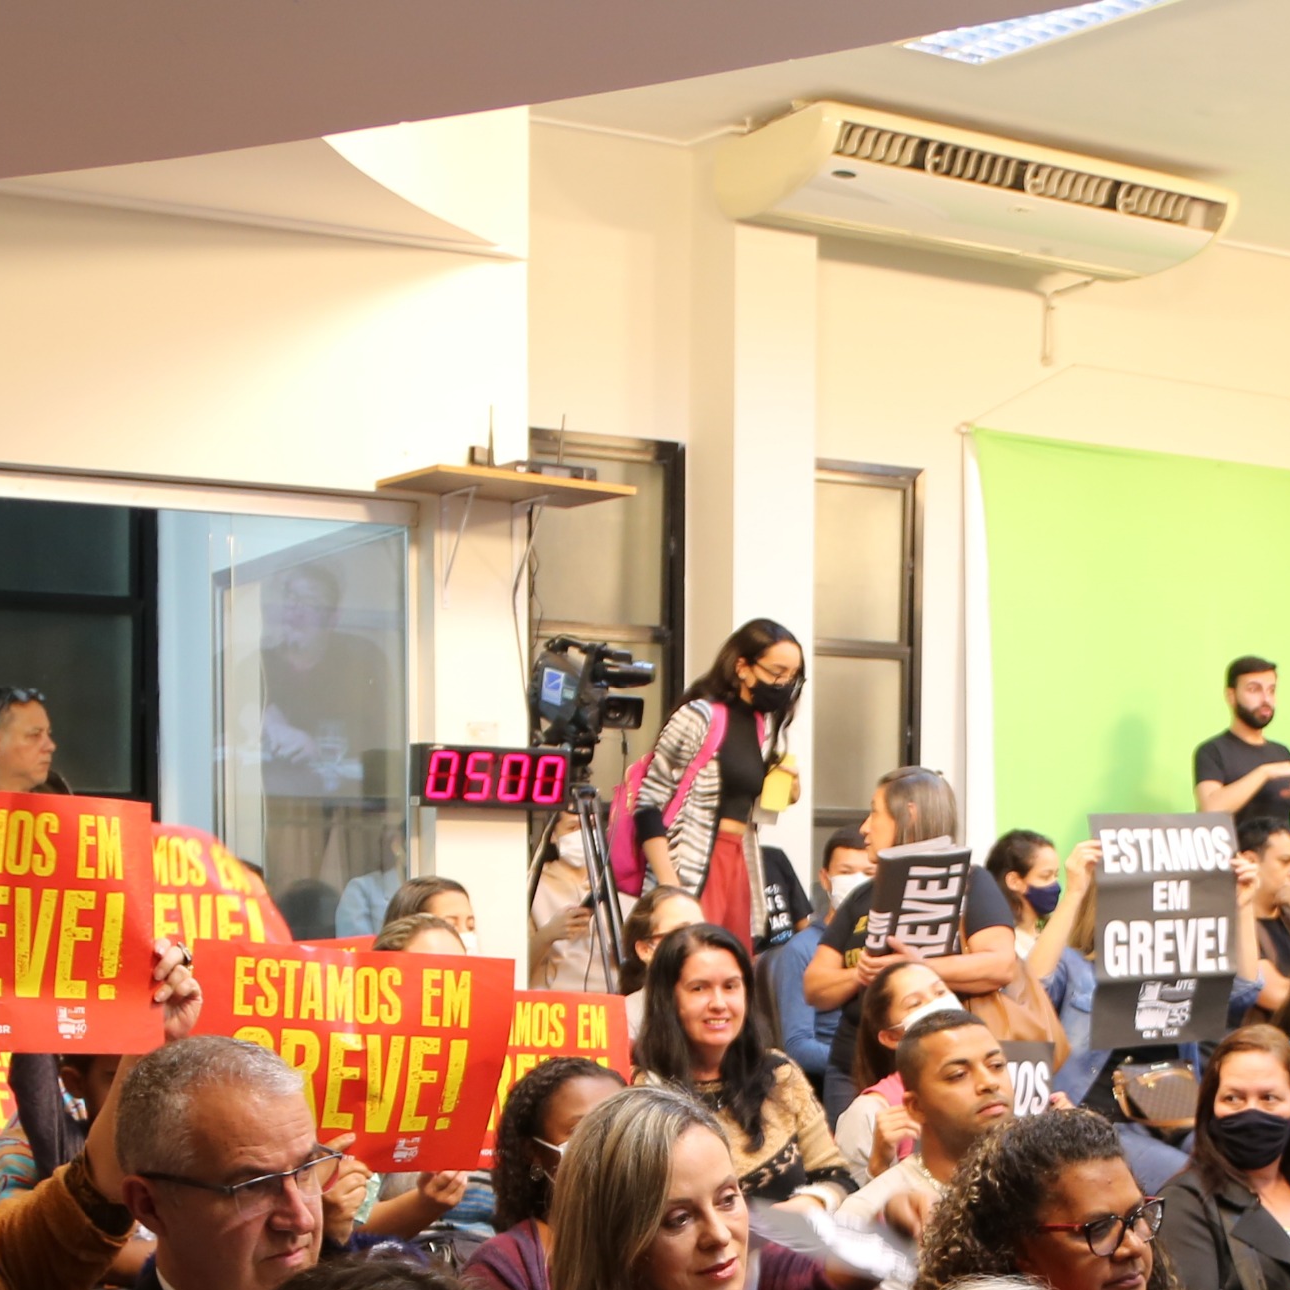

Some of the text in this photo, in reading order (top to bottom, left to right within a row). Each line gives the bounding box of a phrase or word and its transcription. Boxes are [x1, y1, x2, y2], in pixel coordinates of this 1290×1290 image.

[76, 813, 124, 880] EM
[1099, 826, 1234, 875] ESTAMOS
[153, 893, 266, 948] EVE!
[1152, 880, 1190, 912] EM
[1103, 917, 1230, 978] GREVE!
[233, 957, 402, 1026] ESTAMOS
[421, 968, 472, 1029] EM
[577, 1004, 607, 1049] EM
[232, 1026, 469, 1133] REVE!
